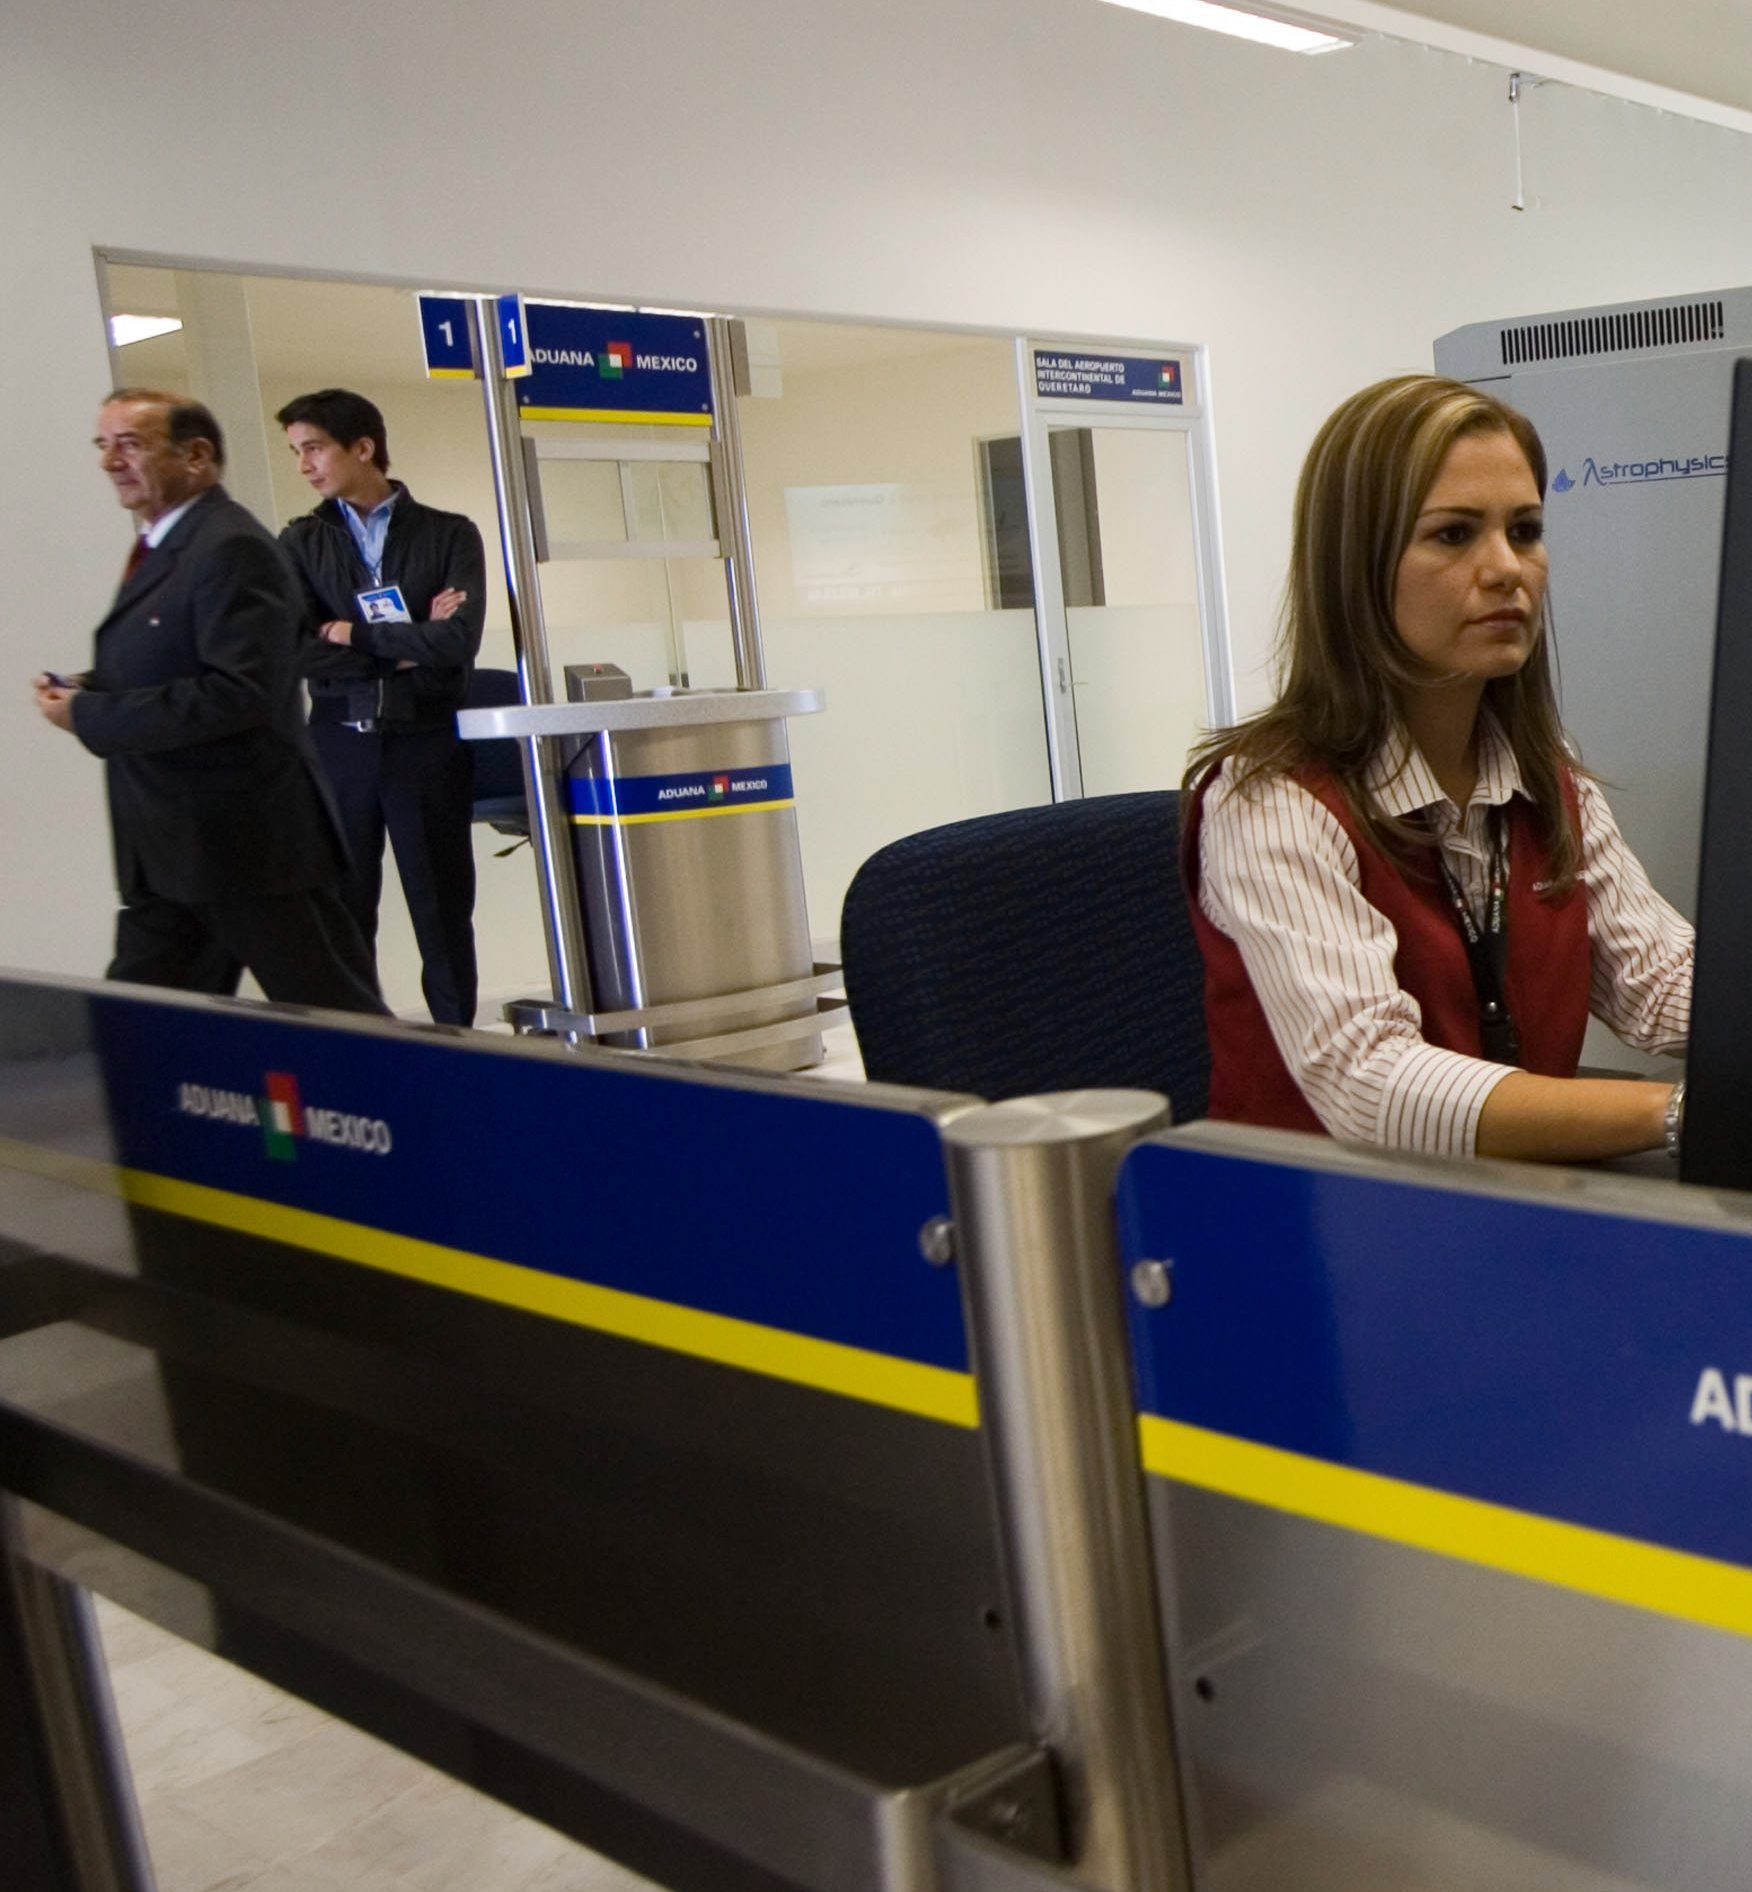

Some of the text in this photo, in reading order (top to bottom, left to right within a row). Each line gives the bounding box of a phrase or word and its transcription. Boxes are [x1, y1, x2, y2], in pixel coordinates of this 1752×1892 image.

[439, 321, 454, 347] 1
[507, 318, 518, 345] 1
[636, 354, 698, 373] MEXICO
[1036, 357, 1125, 373] SALA DEL AEROPUERTO
[1037, 369, 1125, 385] INTERCONTINENTAL DE
[1583, 454, 1728, 486] Astrophysic
[657, 779, 768, 801] ADUANA MEXICO
[179, 1082, 393, 1156] ADUANA MEXICO
